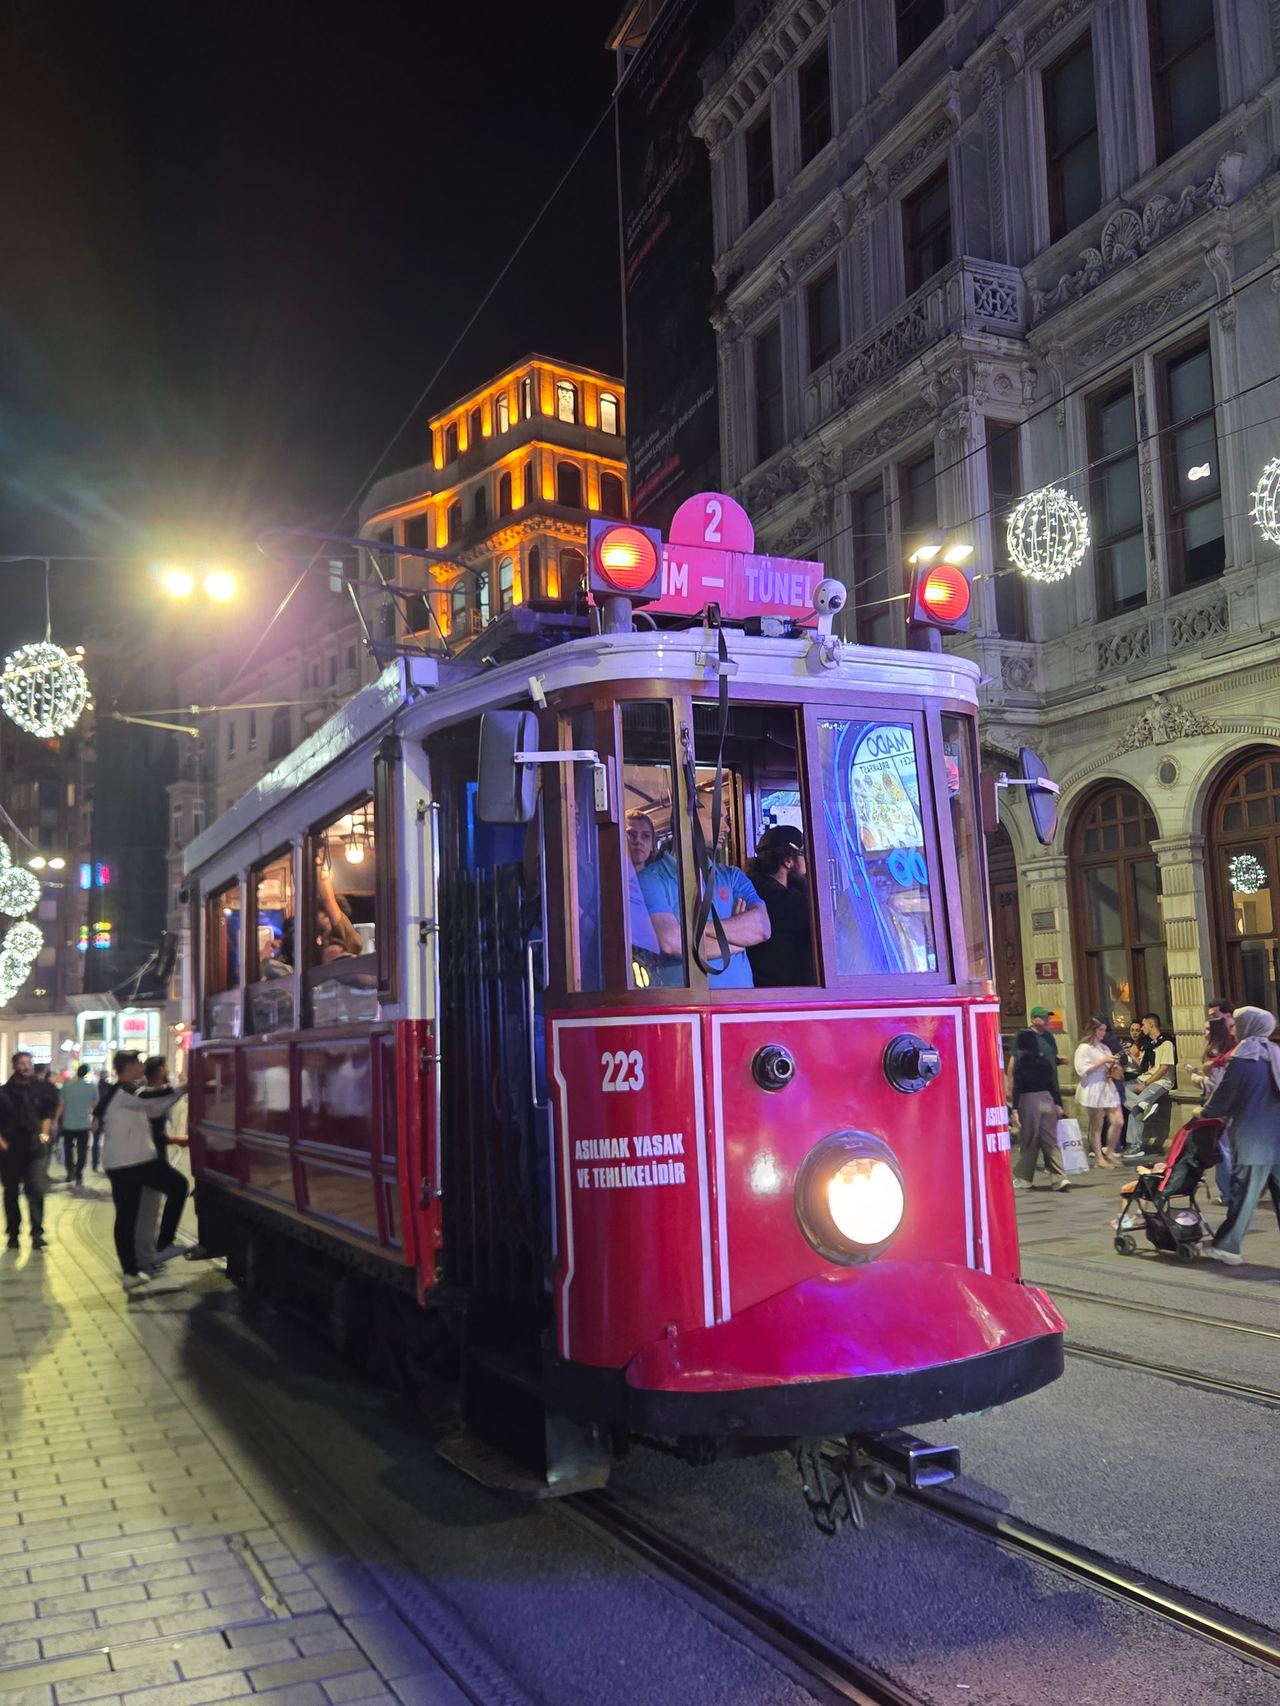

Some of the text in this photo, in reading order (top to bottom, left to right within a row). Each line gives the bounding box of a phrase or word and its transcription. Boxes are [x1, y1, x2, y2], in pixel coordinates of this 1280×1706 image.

[704, 500, 722, 543] 2
[661, 551, 689, 598] İM
[744, 560, 814, 609] TÜNEL
[601, 1050, 644, 1092] 223
[575, 1133, 685, 1160] ASILMAK YASAK
[577, 1159, 686, 1188] VE TEHLİKELİDİR
